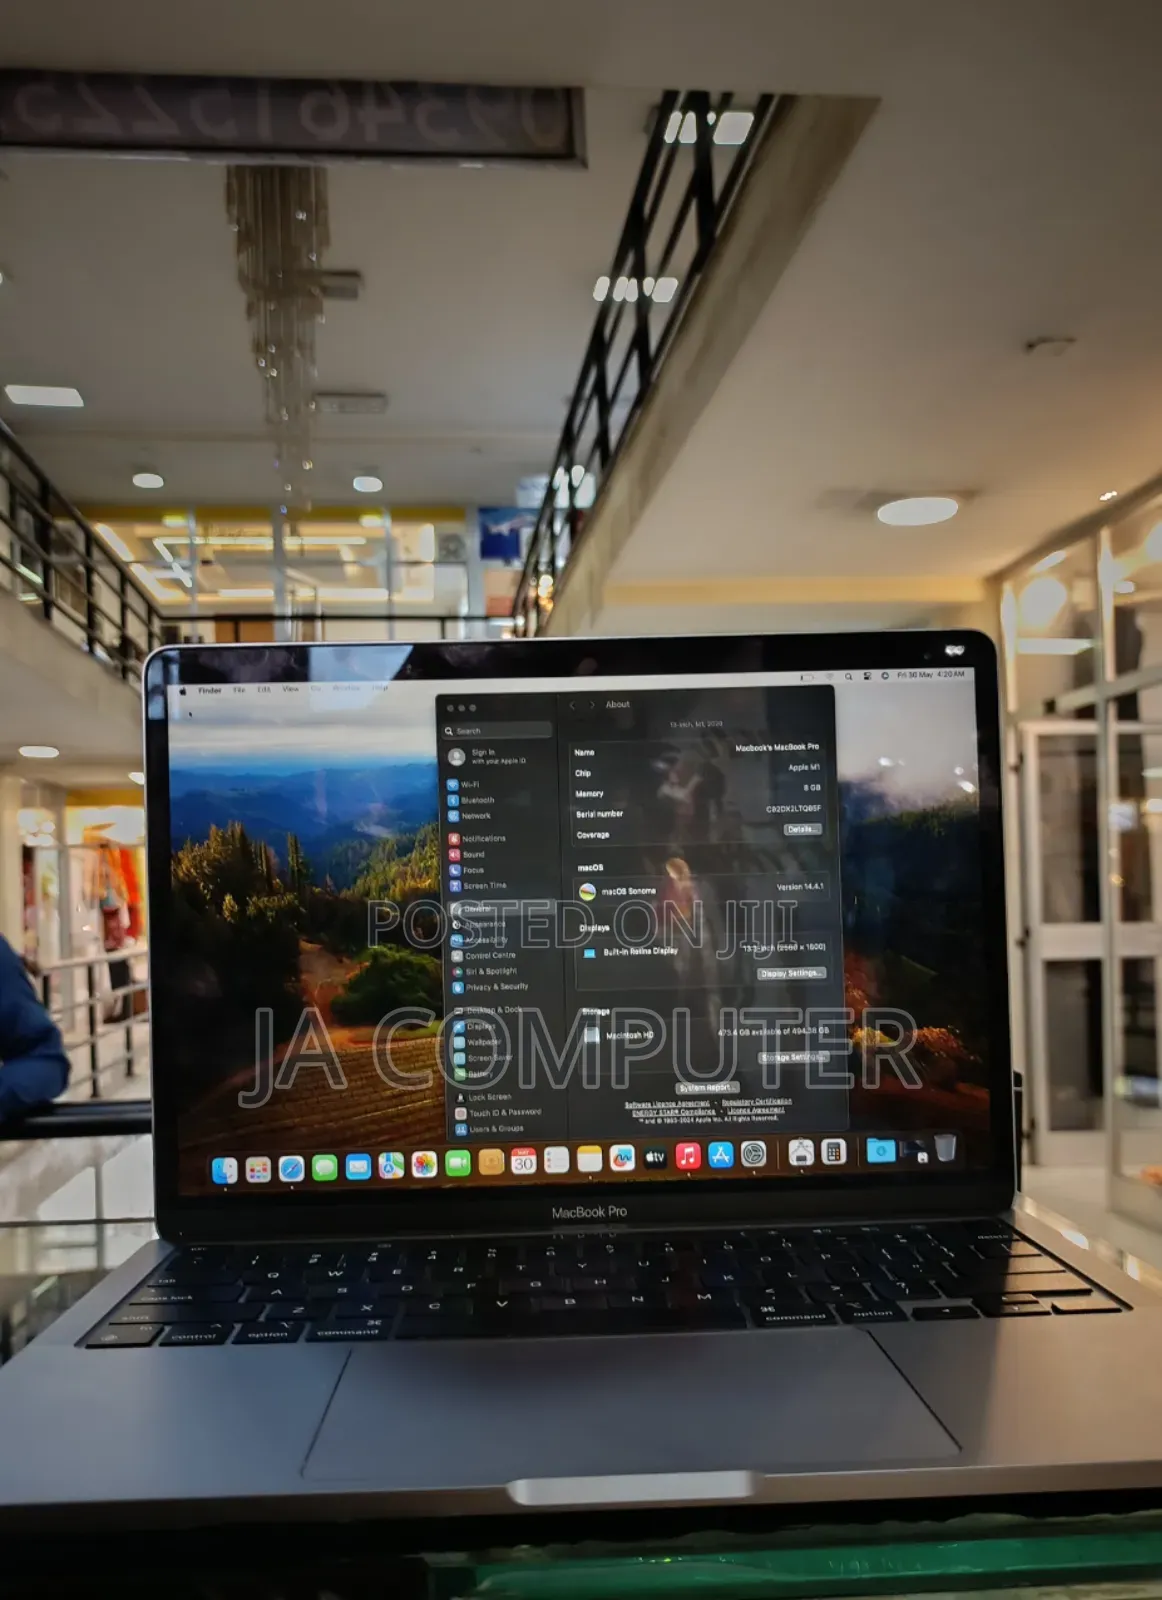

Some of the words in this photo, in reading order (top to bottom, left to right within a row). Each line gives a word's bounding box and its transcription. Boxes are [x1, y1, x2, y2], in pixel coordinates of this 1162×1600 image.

[908, 671, 918, 679] 30
[919, 671, 933, 679] May
[937, 670, 952, 678] 4:20
[198, 686, 222, 695] Finder
[282, 685, 299, 693] View
[605, 700, 631, 709] About
[456, 727, 481, 736] Search
[774, 743, 806, 751] MacBook
[807, 742, 820, 750] Pro
[472, 749, 487, 757] Sign
[574, 748, 595, 756] Name
[788, 763, 808, 772] Apple
[810, 763, 820, 771] M1
[575, 769, 591, 778] Chip
[461, 780, 480, 788] Wi-Fi
[575, 790, 604, 799] Memory
[461, 796, 495, 805] Bluetooth
[462, 812, 491, 820] Network
[576, 810, 596, 818] Serial
[597, 809, 624, 818] number
[462, 835, 506, 843] Notifications
[577, 831, 610, 840] Coverage
[463, 851, 485, 859] Sound
[463, 866, 485, 874] Focus
[577, 863, 604, 872] macOS
[463, 882, 488, 890] Screen
[776, 883, 803, 891] Version
[804, 882, 824, 890] 14.4.1
[602, 888, 627, 896] macOS
[628, 887, 657, 895] Sonoma
[579, 924, 610, 933] Displays
[465, 952, 491, 960] Control
[492, 951, 516, 959] Centre
[603, 948, 629, 957] Built-in
[630, 947, 652, 956] Retina
[653, 947, 679, 956] Display
[761, 969, 787, 978] Display
[466, 983, 492, 992] Privacy
[500, 982, 529, 991] Security
[606, 1030, 642, 1040] Macintosh
[469, 1109, 491, 1117] Touch
[492, 1109, 500, 1117] ID
[508, 1108, 542, 1117] Password
[469, 1125, 490, 1133] Users
[499, 1124, 524, 1133] Groups
[653, 1153, 664, 1162] tv
[514, 1157, 533, 1170] 30
[551, 1206, 606, 1220] MacBook
[608, 1206, 628, 1219] Pro
[765, 1313, 827, 1322] command
[853, 1309, 894, 1318] option
[316, 1328, 380, 1336] command
